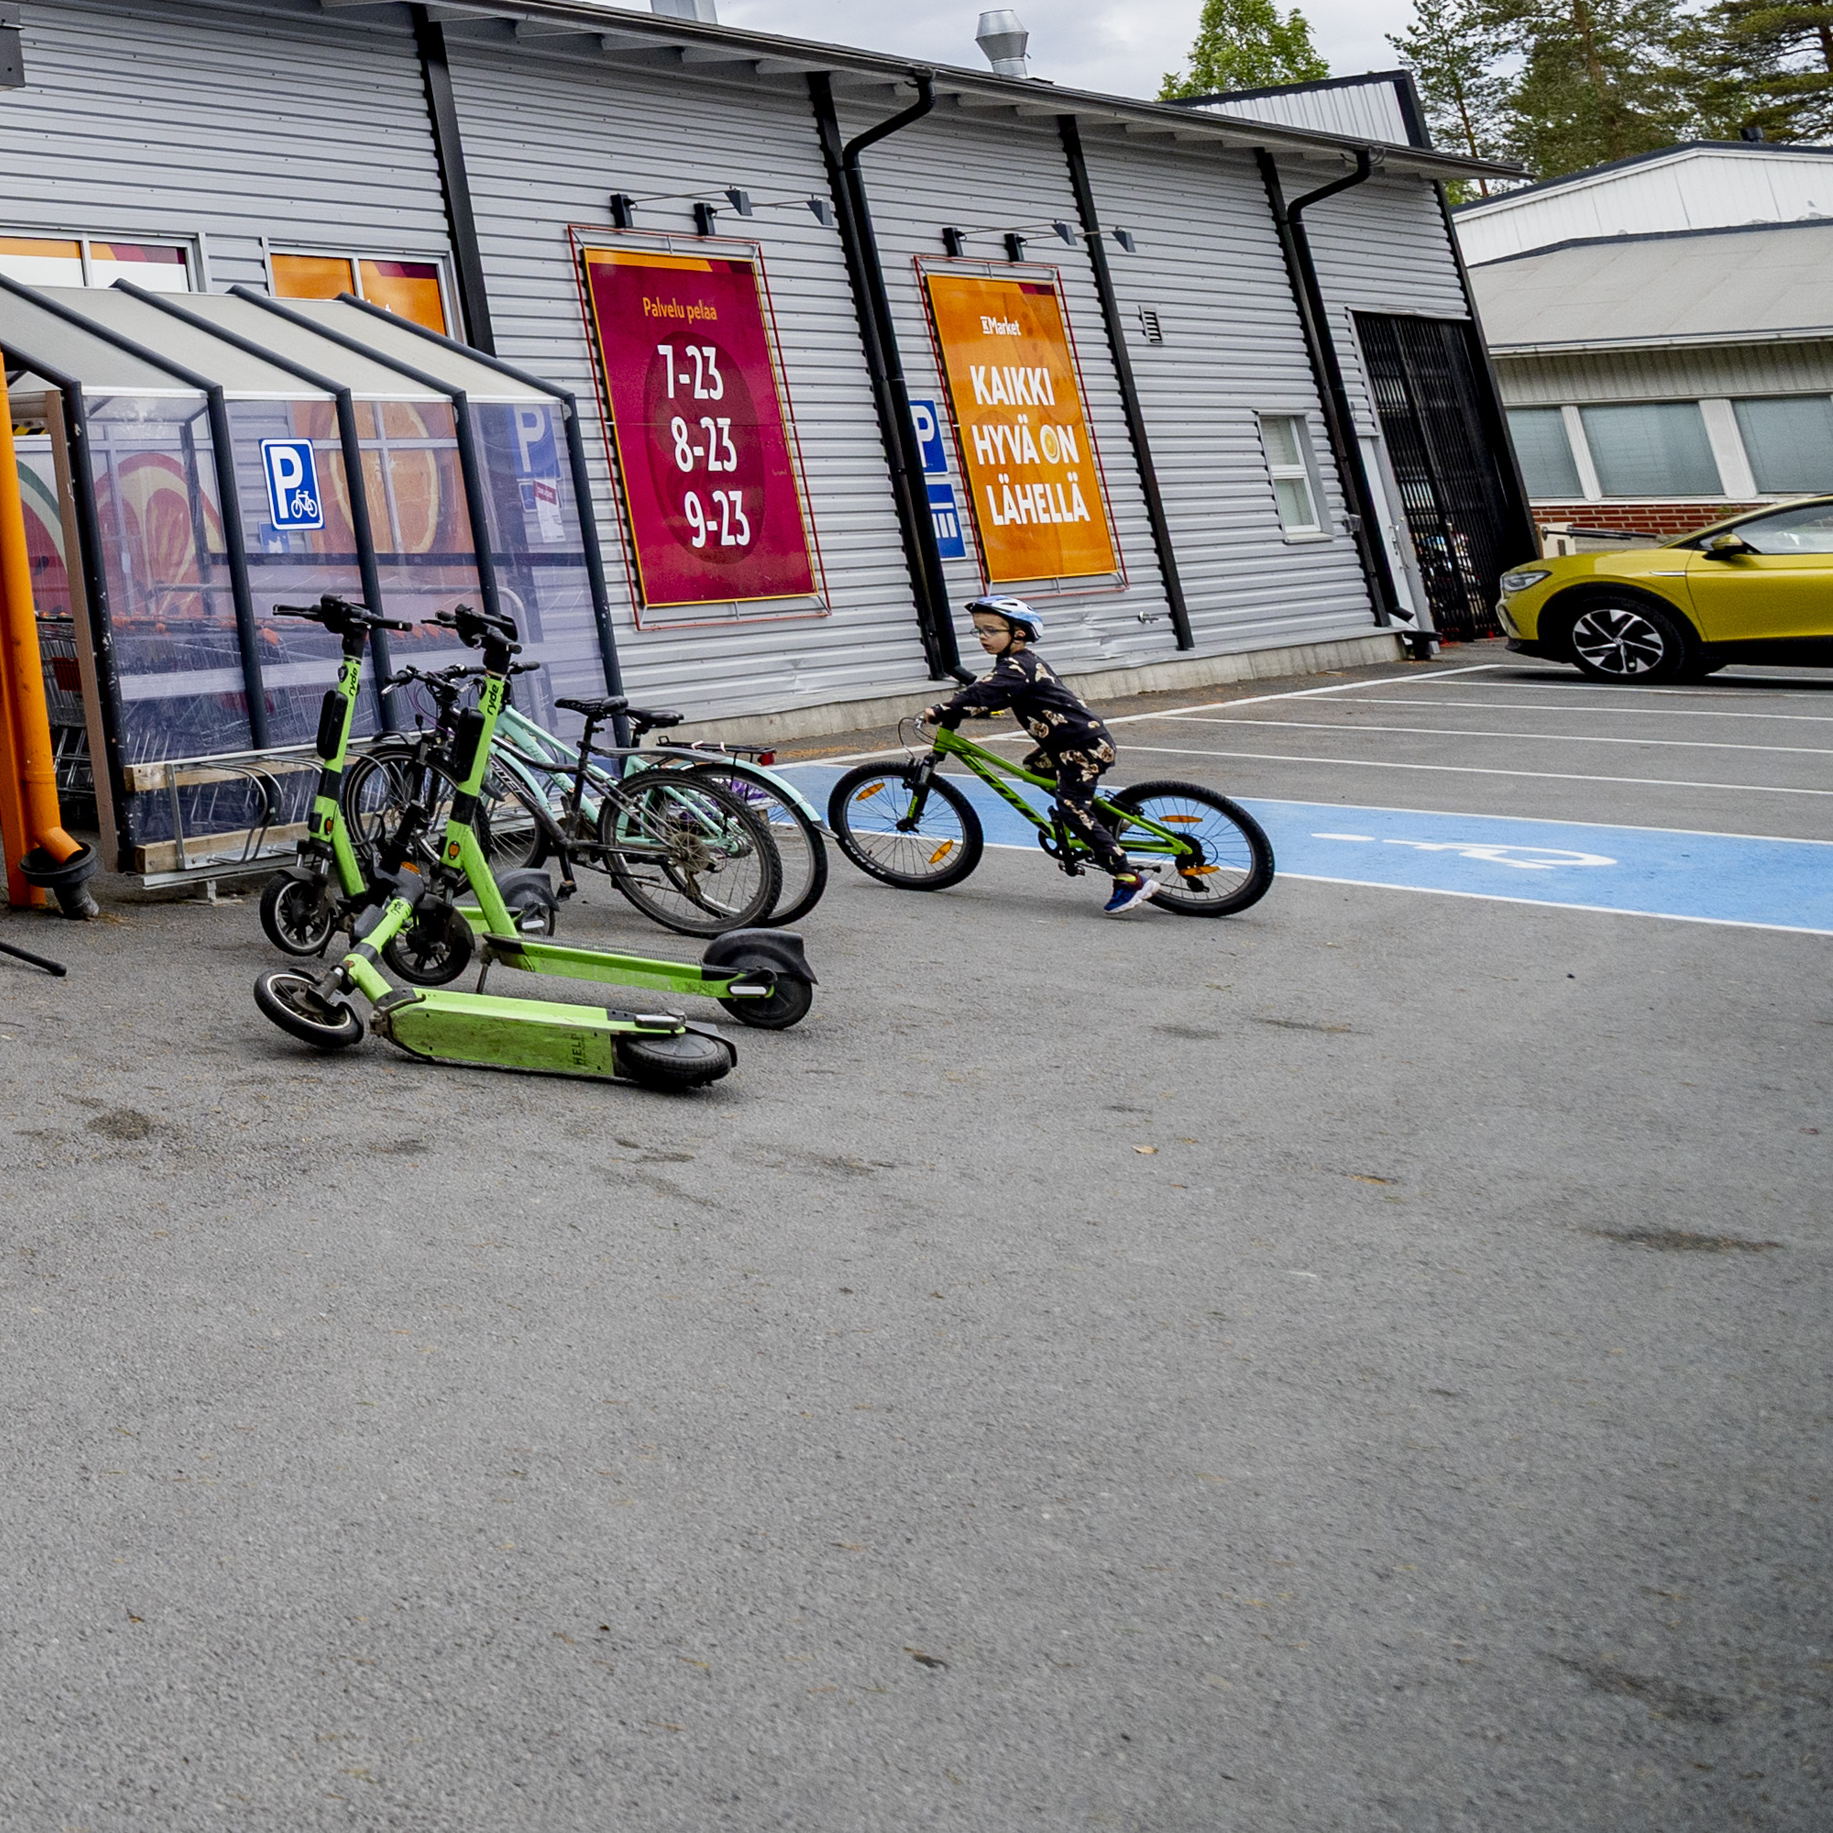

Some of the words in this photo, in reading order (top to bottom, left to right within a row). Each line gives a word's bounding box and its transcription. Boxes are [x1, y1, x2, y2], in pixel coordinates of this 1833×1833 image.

[642, 296, 685, 318] Palvelu
[686, 299, 718, 324] pelaa
[657, 344, 724, 401] 7-23
[970, 365, 1055, 406] KAIKKI
[514, 405, 546, 473] P
[672, 416, 738, 473] 8-23
[971, 414, 1041, 465] HYVÄ
[1040, 423, 1080, 465] ON
[269, 446, 304, 519] P
[986, 471, 1090, 526] LÄHELLÄ
[684, 490, 751, 549] 9-23
[349, 667, 358, 697] ryde
[486, 684, 500, 716] ryde
